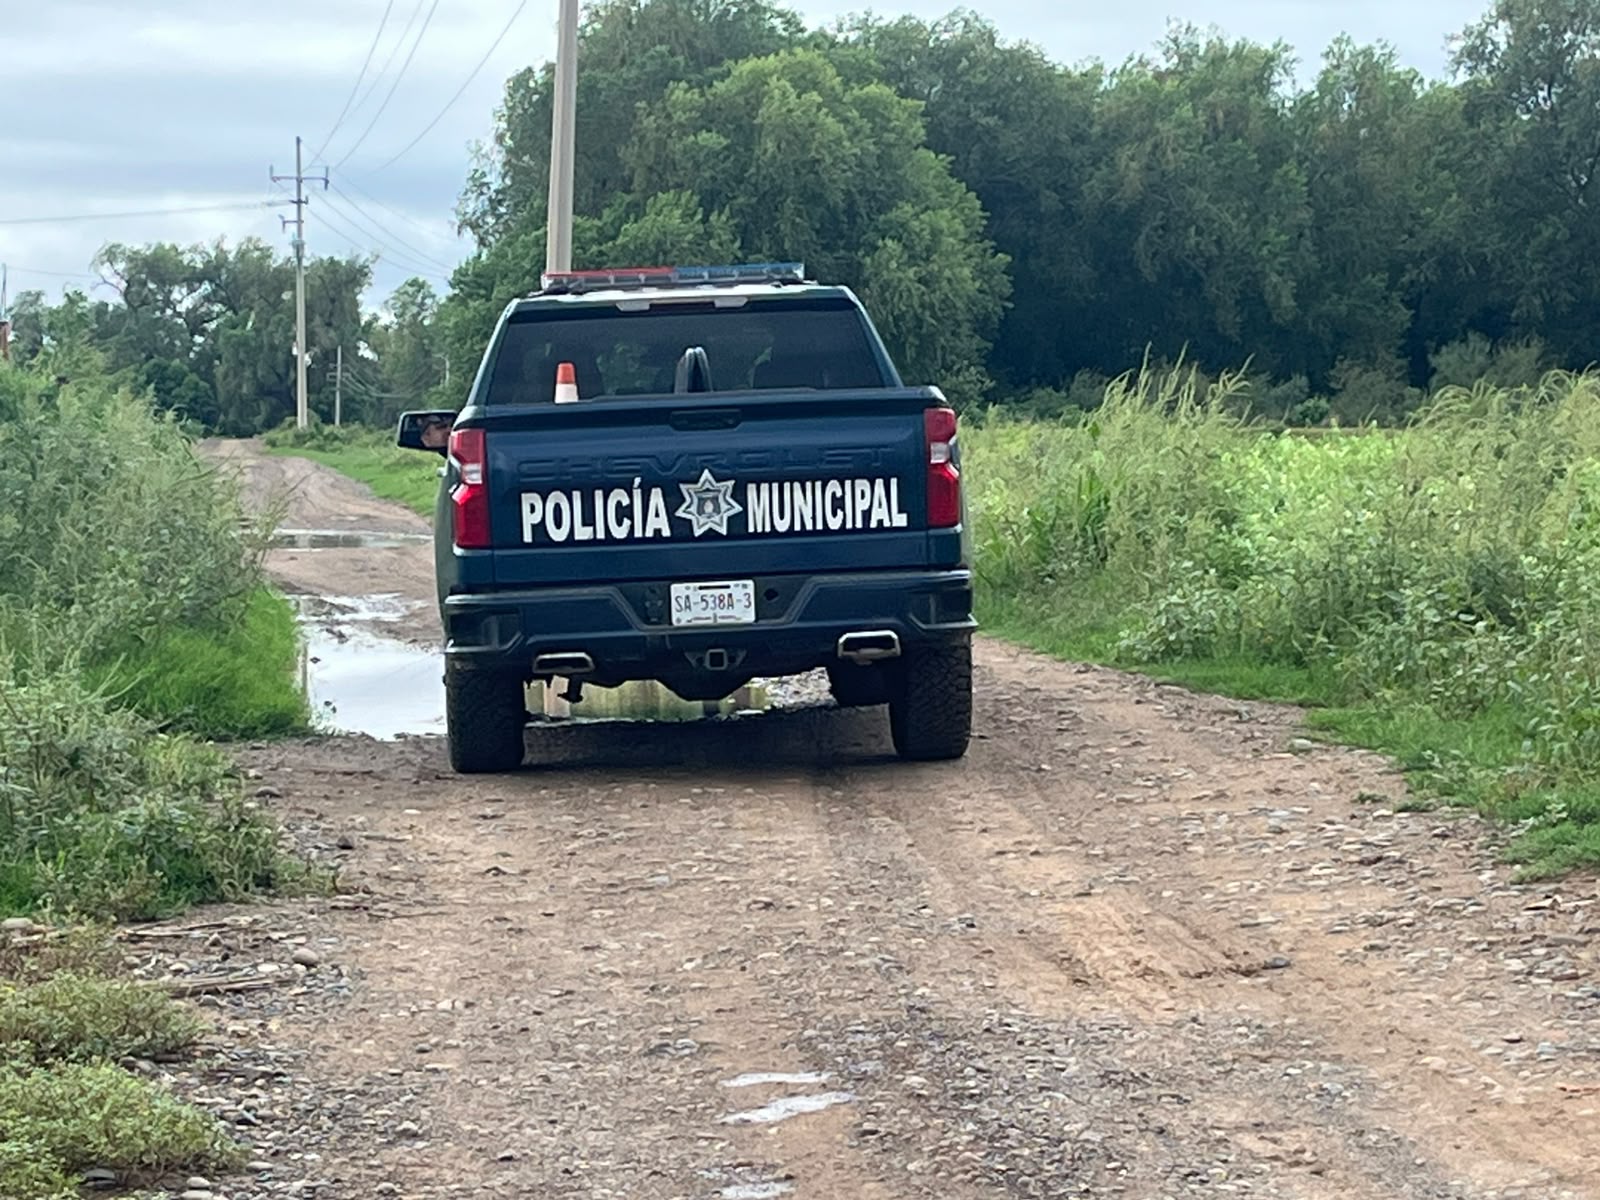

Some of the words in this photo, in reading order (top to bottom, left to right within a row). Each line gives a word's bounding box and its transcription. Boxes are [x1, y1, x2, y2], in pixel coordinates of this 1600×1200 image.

[517, 447, 894, 482] CHEVROLET
[520, 477, 671, 542] POLICÍA
[746, 477, 908, 533] MUNICIPAL
